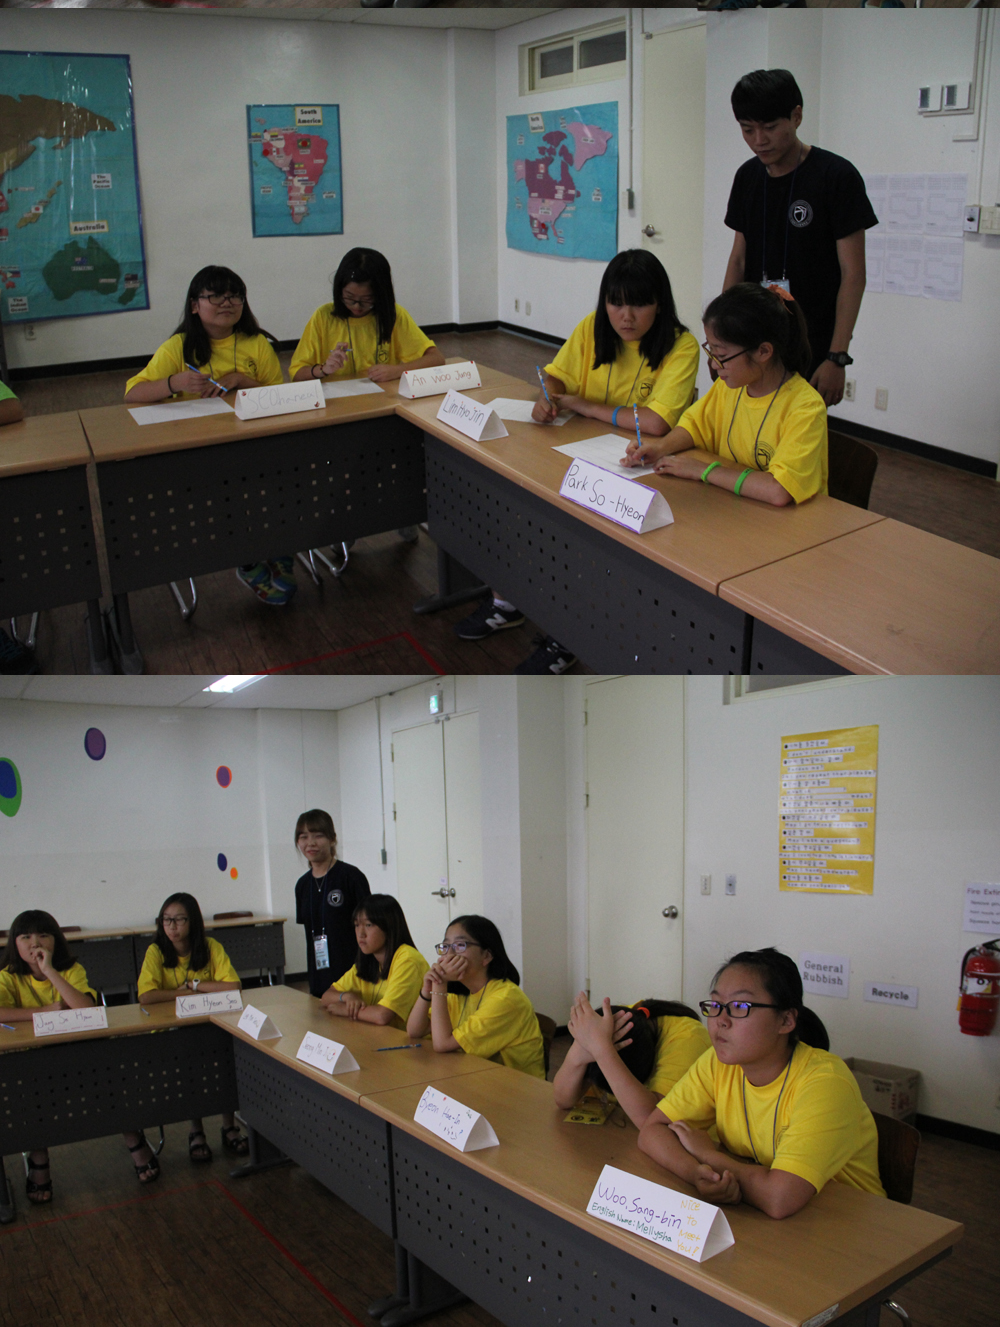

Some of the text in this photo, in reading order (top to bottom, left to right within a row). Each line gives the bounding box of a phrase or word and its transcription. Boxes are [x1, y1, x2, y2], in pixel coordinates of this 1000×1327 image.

[565, 464, 588, 491] Park
[967, 887, 981, 895] Fire
[804, 960, 844, 974] General
[803, 972, 843, 986] Rubbish
[871, 988, 909, 1001] Recycle
[178, 997, 196, 1012] Kim
[592, 1202, 615, 1219] English
